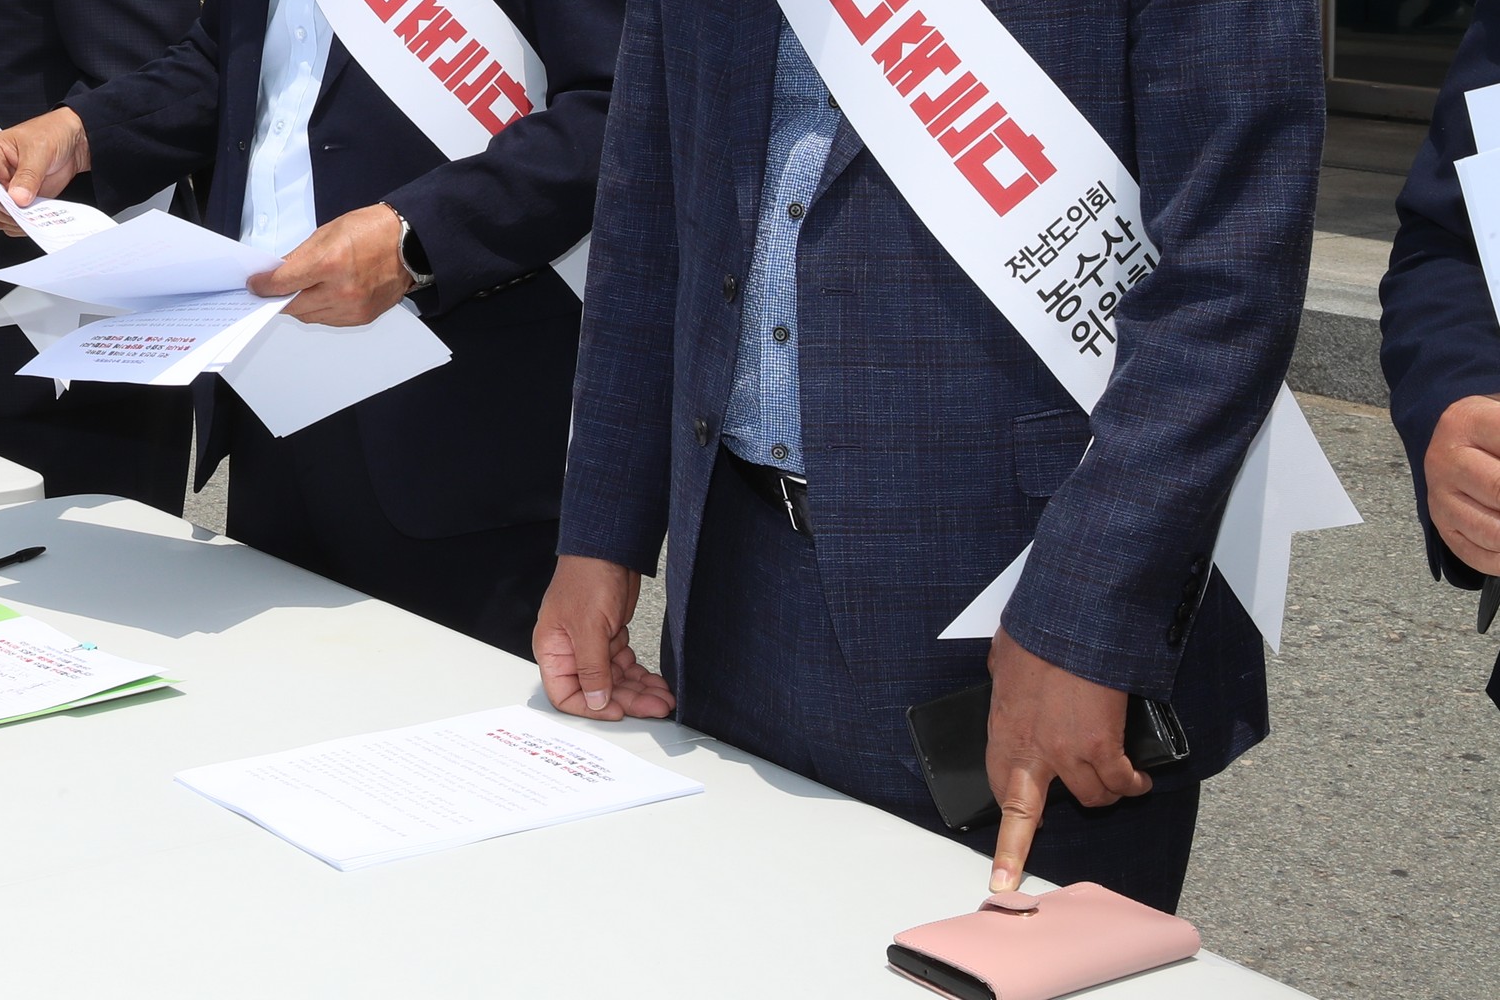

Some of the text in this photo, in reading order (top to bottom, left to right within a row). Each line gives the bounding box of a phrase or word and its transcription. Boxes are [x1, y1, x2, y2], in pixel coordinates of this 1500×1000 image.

[872, 10, 1057, 218] 죽는다
[1004, 180, 1117, 282] 전남도의회
[1036, 218, 1142, 322] 농수산
